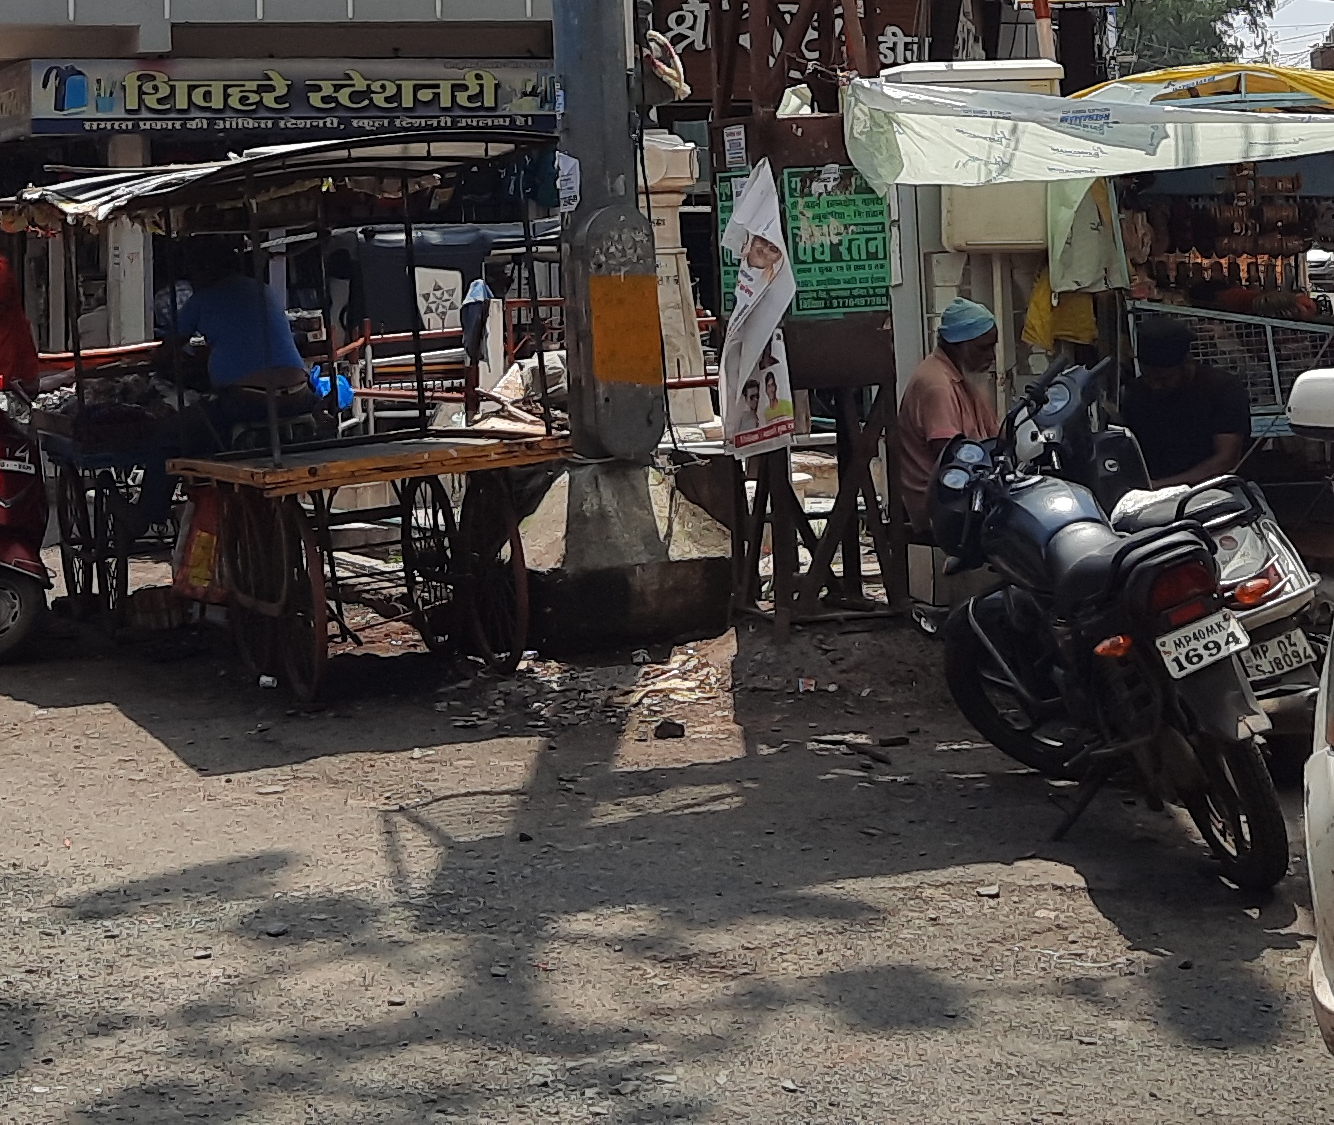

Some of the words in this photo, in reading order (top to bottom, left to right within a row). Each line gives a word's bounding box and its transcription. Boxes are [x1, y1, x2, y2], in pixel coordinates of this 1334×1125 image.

[121, 70, 292, 111] शिवहरे
[304, 69, 499, 109] स्टेशनरी
[138, 120, 182, 131] प्रकार
[393, 117, 452, 129] स्टेशनरी
[839, 233, 886, 261] रतन
[1173, 620, 1227, 651] MP40MK
[1171, 630, 1241, 673] 1694
[1250, 644, 1269, 662] MP
